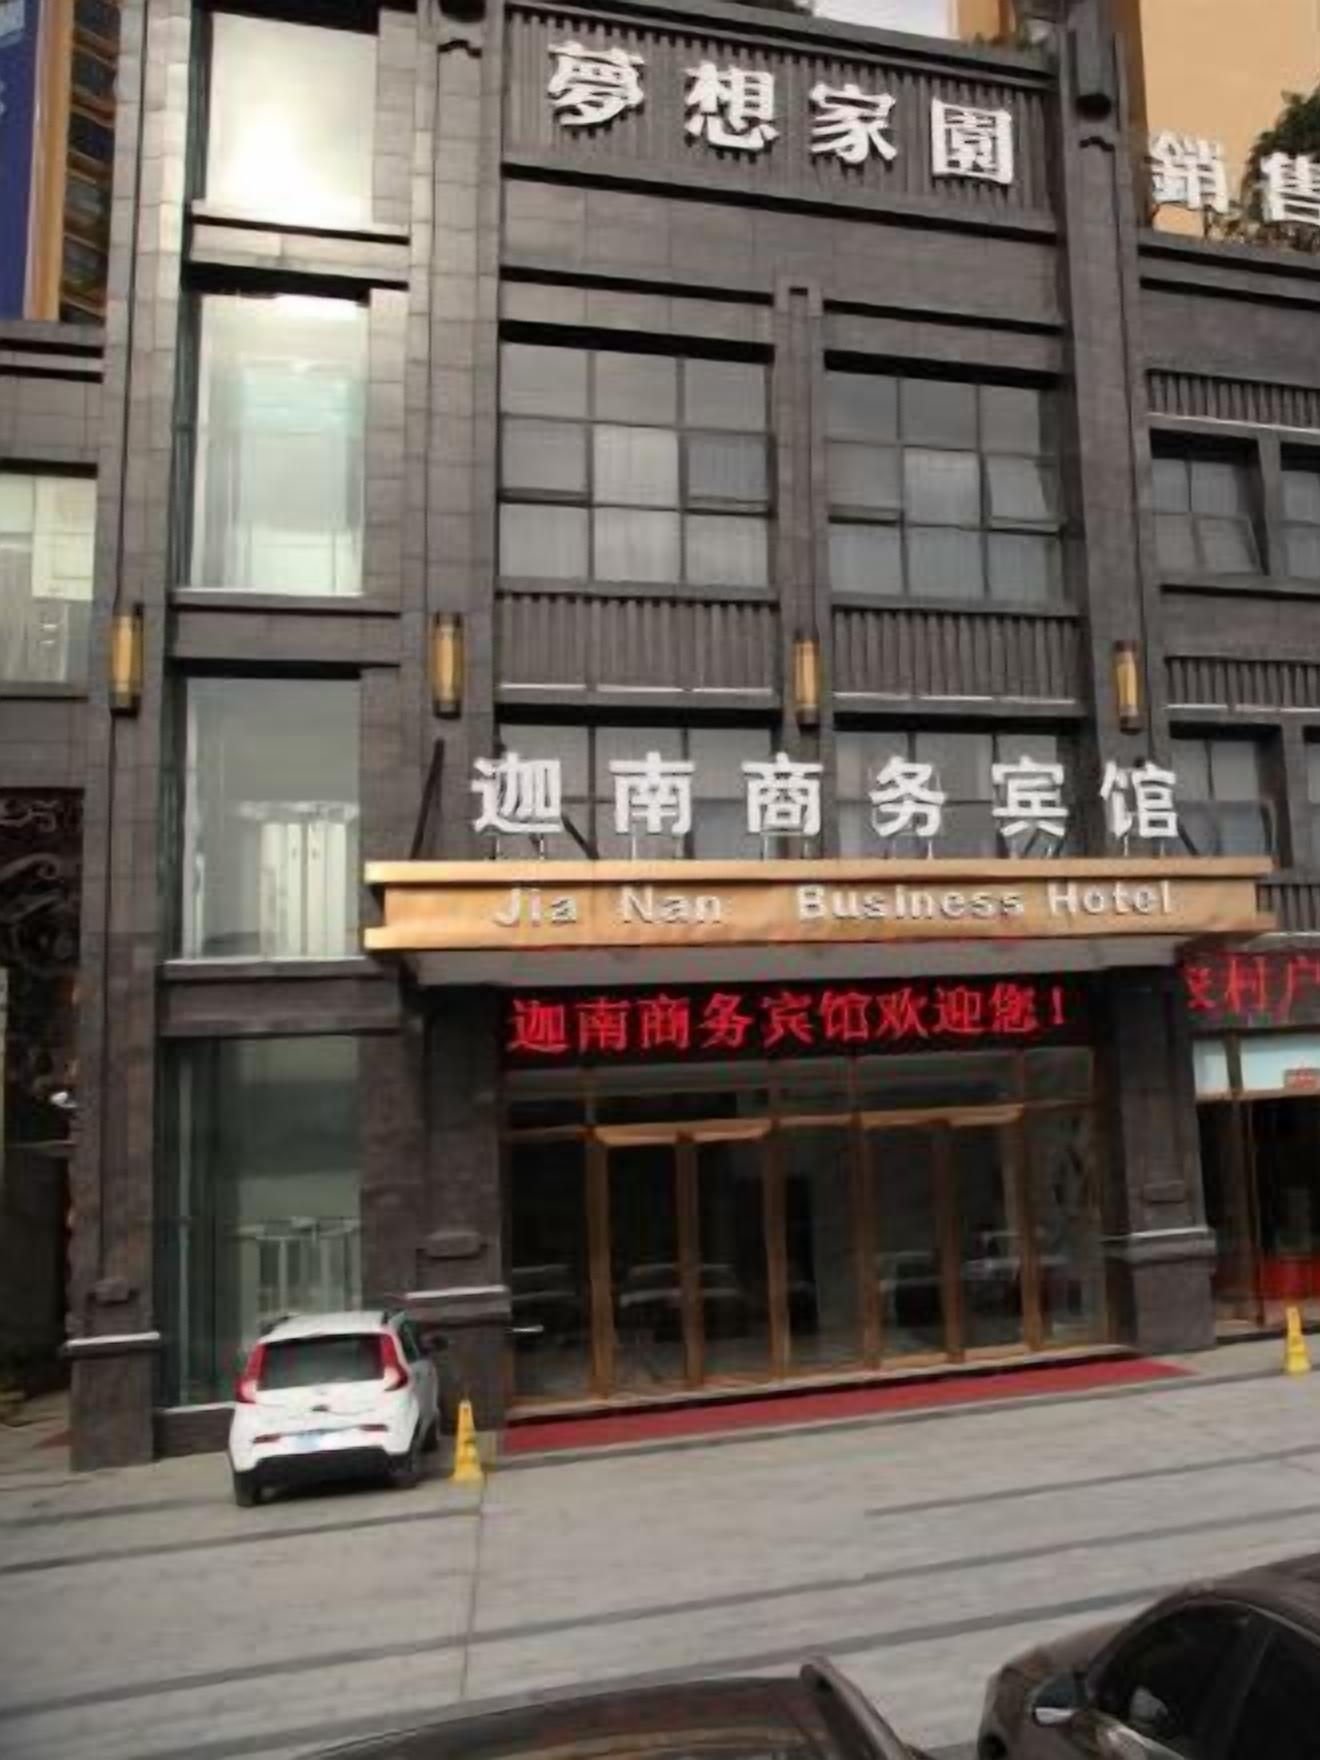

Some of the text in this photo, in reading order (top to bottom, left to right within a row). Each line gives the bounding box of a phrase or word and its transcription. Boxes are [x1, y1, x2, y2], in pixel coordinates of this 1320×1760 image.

[547, 40, 1014, 186] 夢想家園
[469, 750, 1179, 836] 迦南商务宾馆
[494, 878, 1175, 929] Jia Nan Business Hotel
